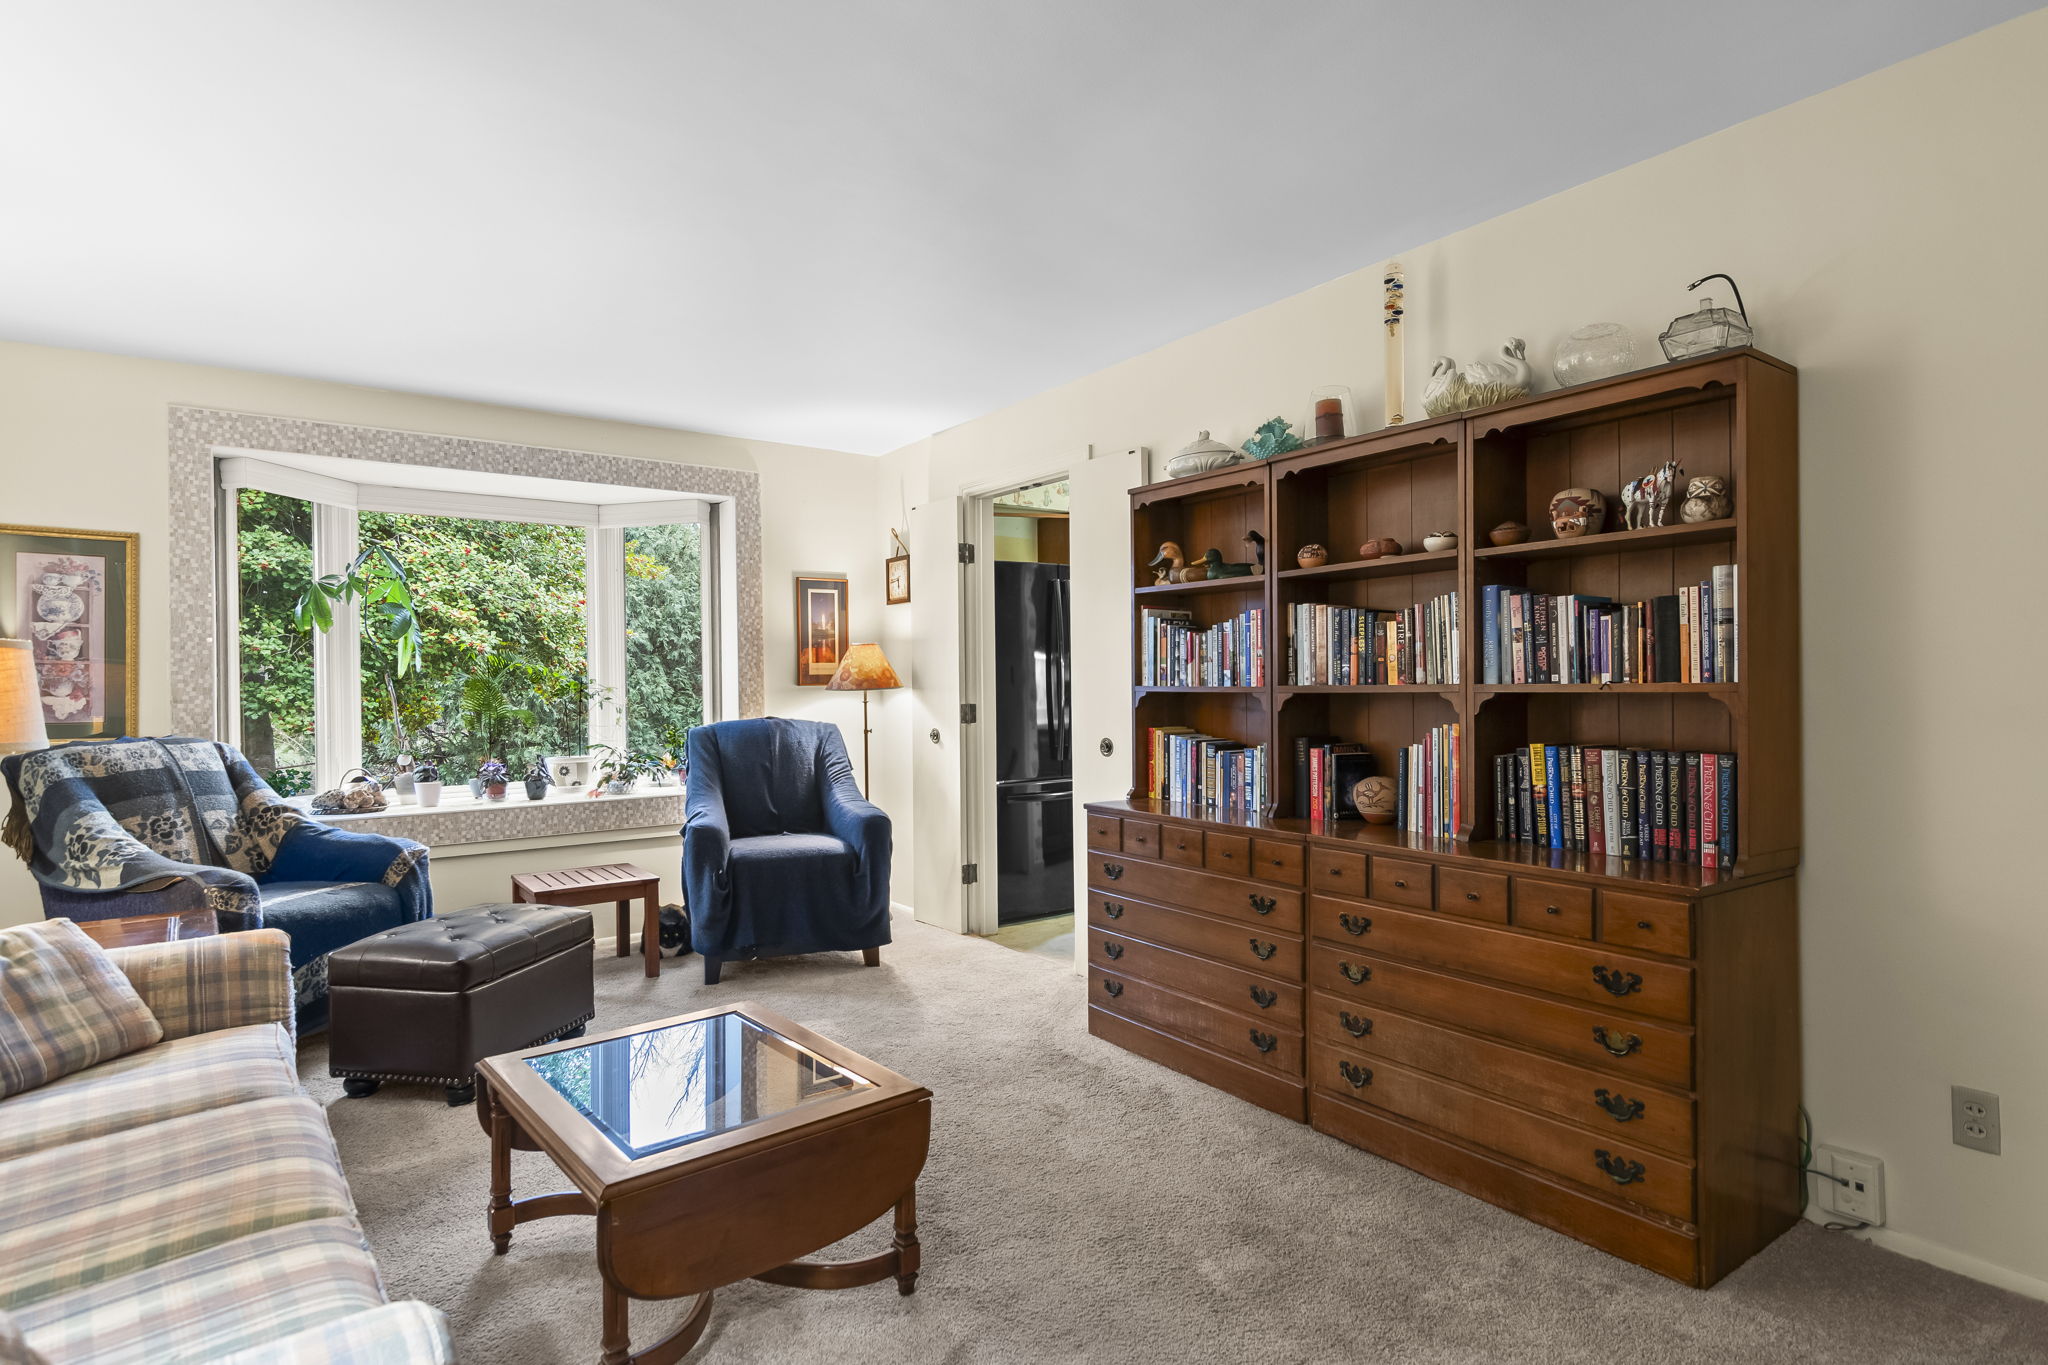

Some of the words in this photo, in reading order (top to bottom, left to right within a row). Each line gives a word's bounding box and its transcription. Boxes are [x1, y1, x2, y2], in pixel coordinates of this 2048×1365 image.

[1539, 597, 1547, 631] STEPHEN
[1397, 624, 1405, 645] FIRE
[1547, 757, 1555, 780] PRESTON
[1621, 759, 1629, 787] PRESTON
[1655, 765, 1664, 794] PRESTON
[1670, 766, 1679, 795] PRESTON
[1687, 767, 1697, 797] PRESTON
[1703, 765, 1714, 801] PRESTON
[1721, 768, 1731, 798] PRESTON
[1536, 803, 1546, 816] DEEP
[1562, 788, 1571, 807] LOST
[1621, 795, 1630, 818] CHILD
[1639, 794, 1647, 814] CHILD
[1670, 795, 1678, 803] &
[1704, 802, 1714, 811] &
[1721, 799, 1730, 807] &
[1655, 801, 1664, 825] CHILD
[1670, 802, 1679, 827] CHILD
[1688, 804, 1697, 828] CHILD
[1720, 806, 1730, 831] CHILD
[1537, 817, 1547, 835] STORM
[1703, 811, 1714, 840] CHILD
